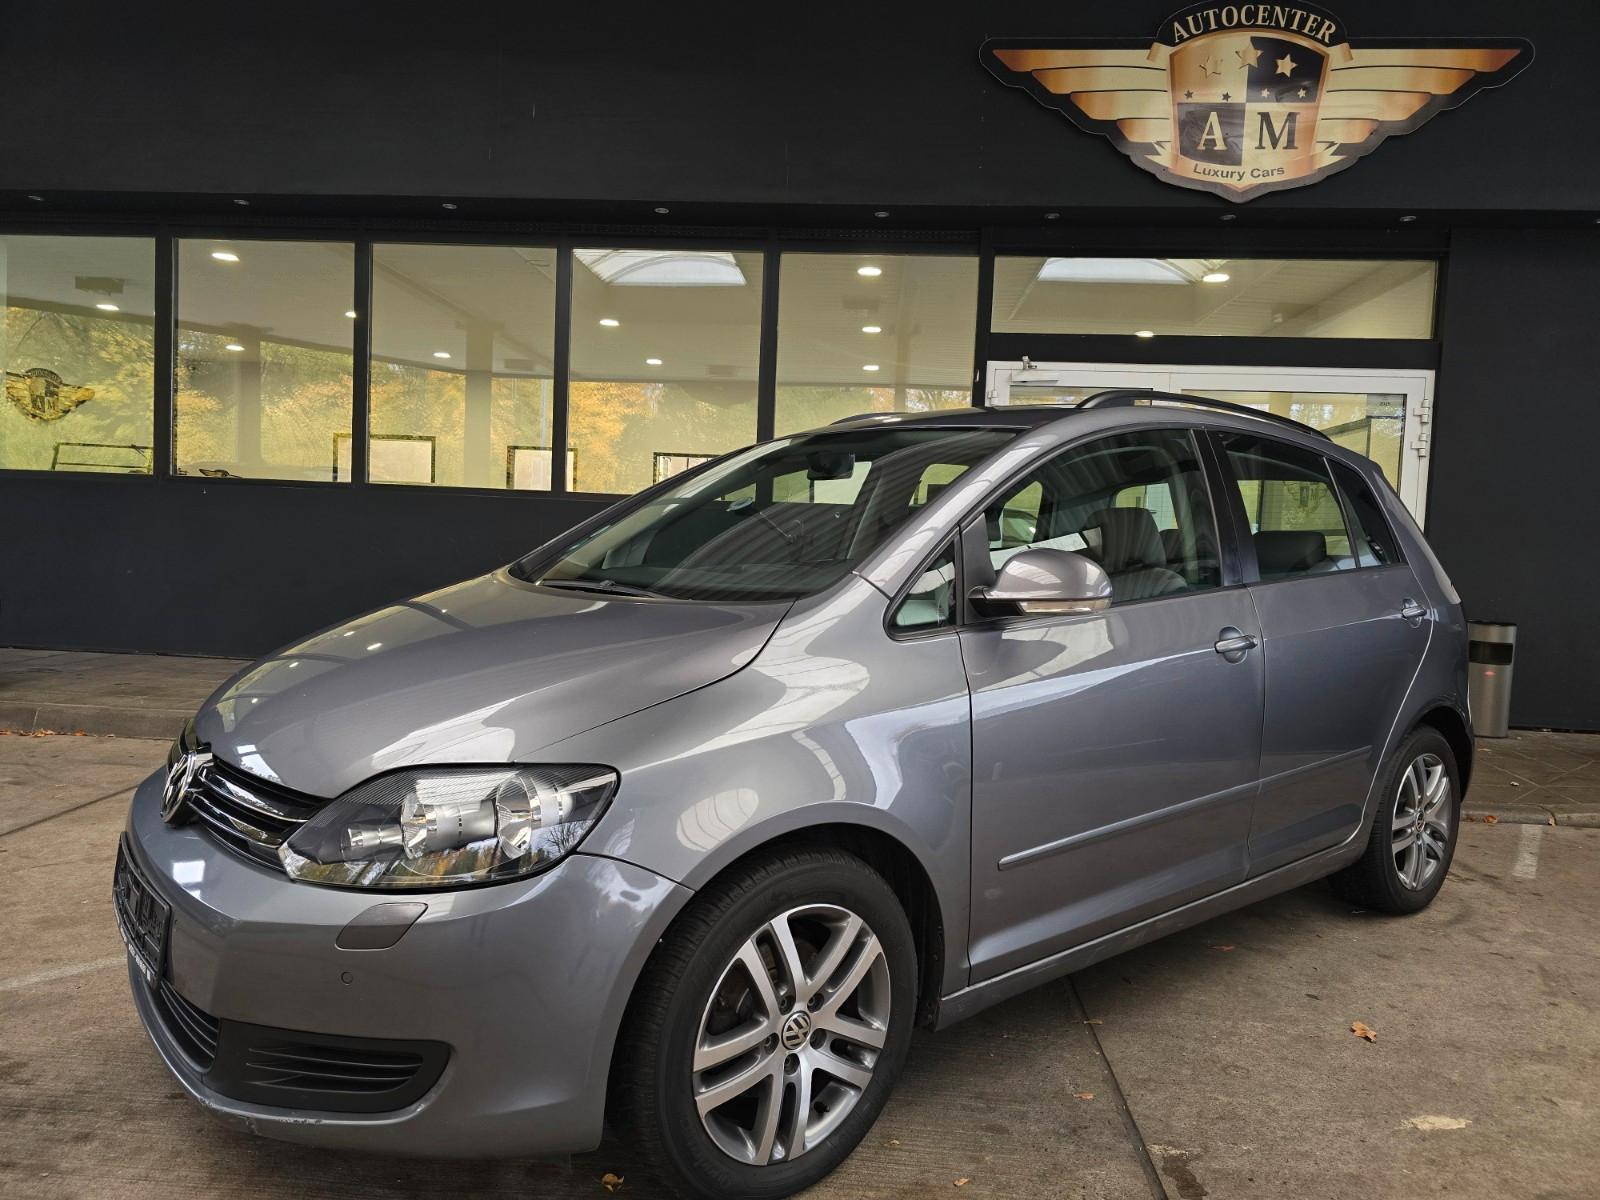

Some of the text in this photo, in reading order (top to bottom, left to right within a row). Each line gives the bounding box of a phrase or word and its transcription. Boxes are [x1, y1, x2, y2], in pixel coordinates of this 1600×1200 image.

[1173, 4, 1337, 43] AUTOCENTER
[1196, 111, 1300, 151] A M
[1193, 163, 1285, 182] Luxury Cars
